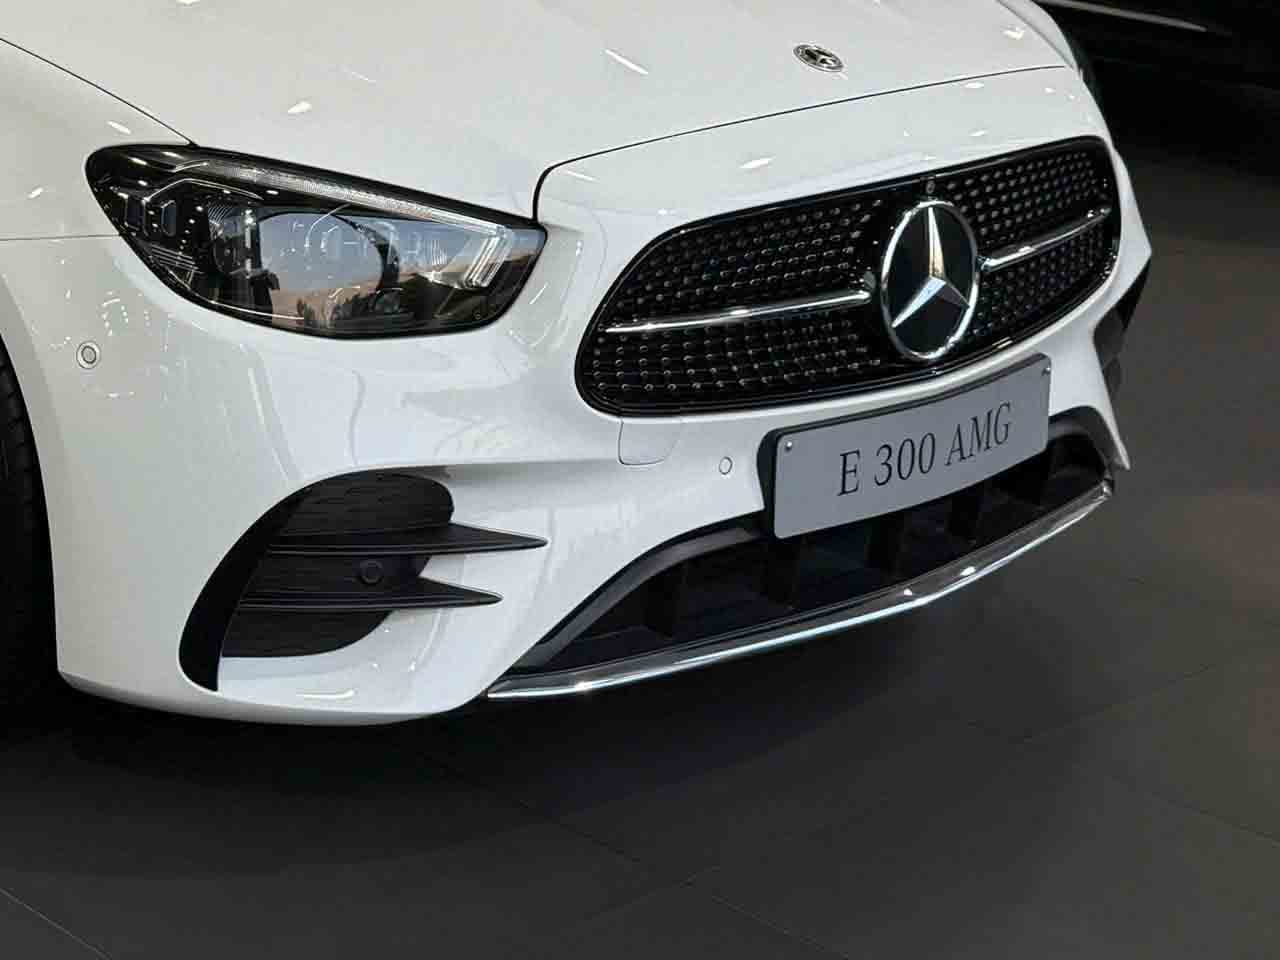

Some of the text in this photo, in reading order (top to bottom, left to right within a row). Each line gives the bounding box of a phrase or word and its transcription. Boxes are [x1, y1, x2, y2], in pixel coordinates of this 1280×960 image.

[837, 401, 1012, 496] E 300 AMG
